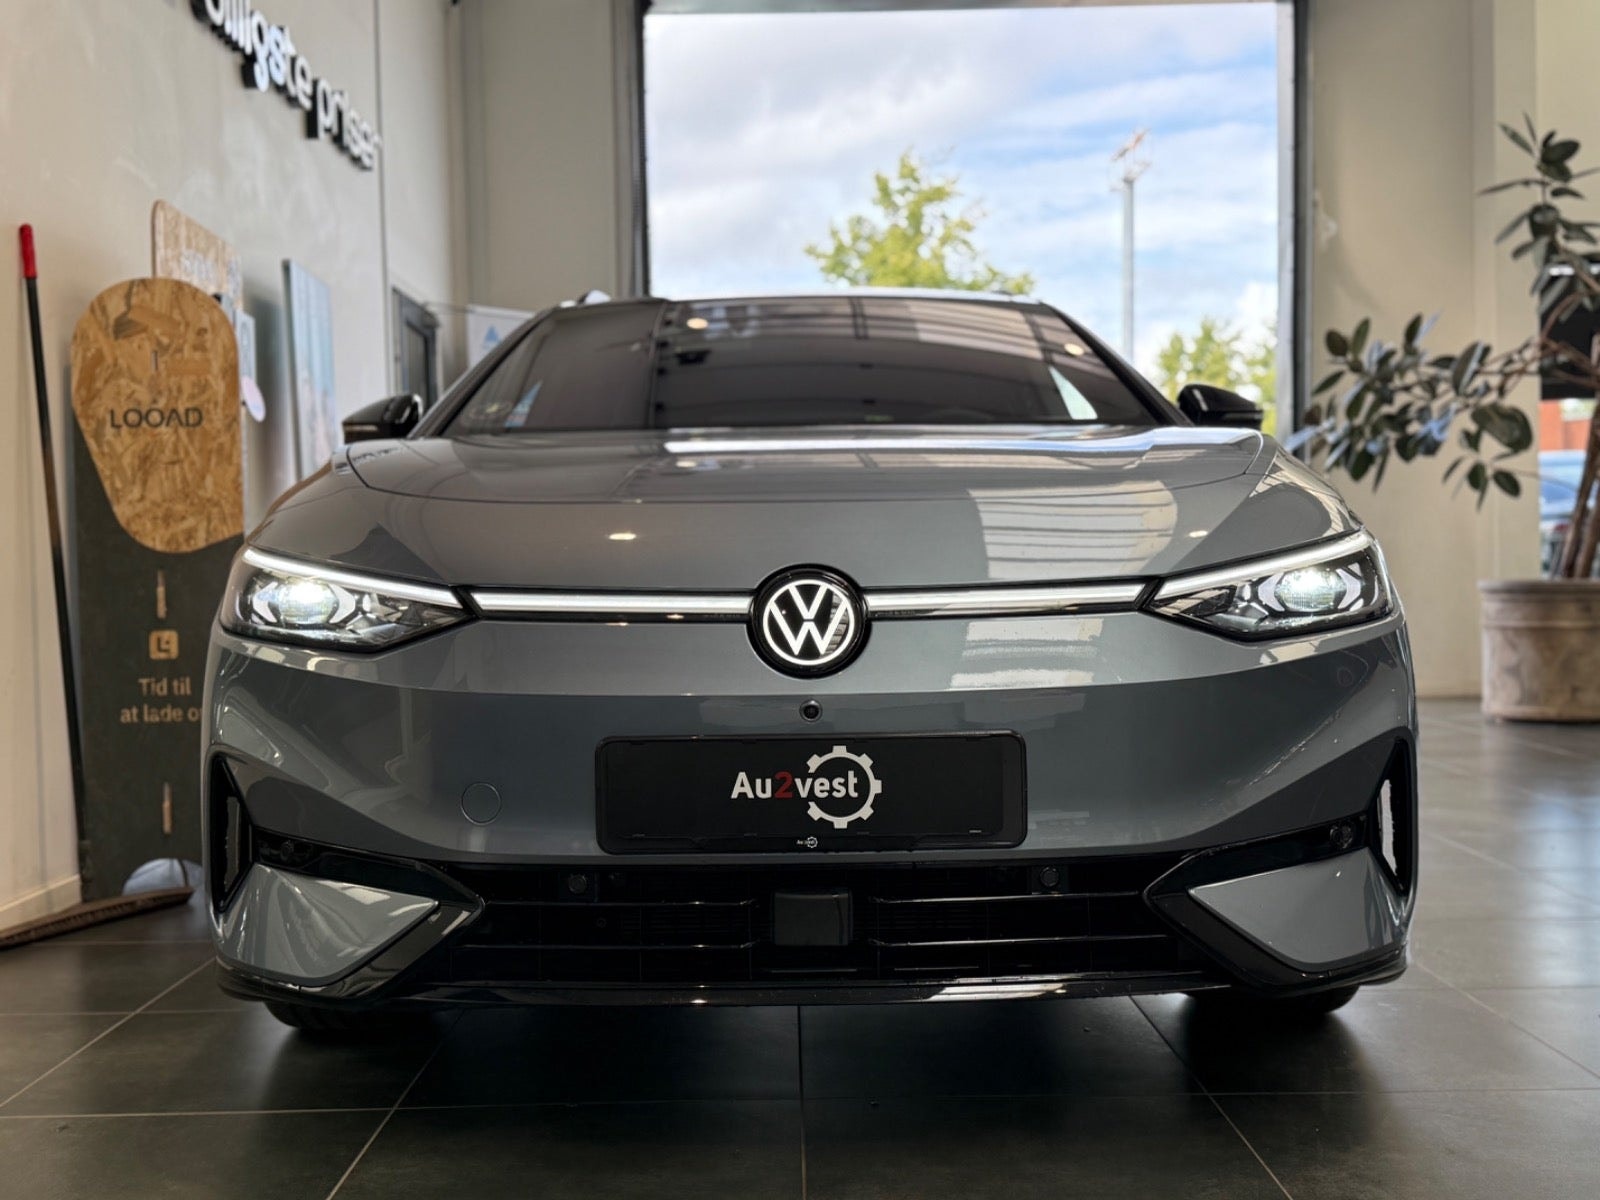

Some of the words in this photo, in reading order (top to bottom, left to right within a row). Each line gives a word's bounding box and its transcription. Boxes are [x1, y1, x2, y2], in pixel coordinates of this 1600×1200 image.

[109, 407, 204, 429] LOOAD
[768, 583, 849, 656] VW
[138, 677, 168, 696] Tid
[173, 676, 192, 696] til
[120, 705, 139, 723] at
[143, 703, 184, 723] lade
[187, 707, 203, 722] o
[730, 770, 859, 799] Au2vest
